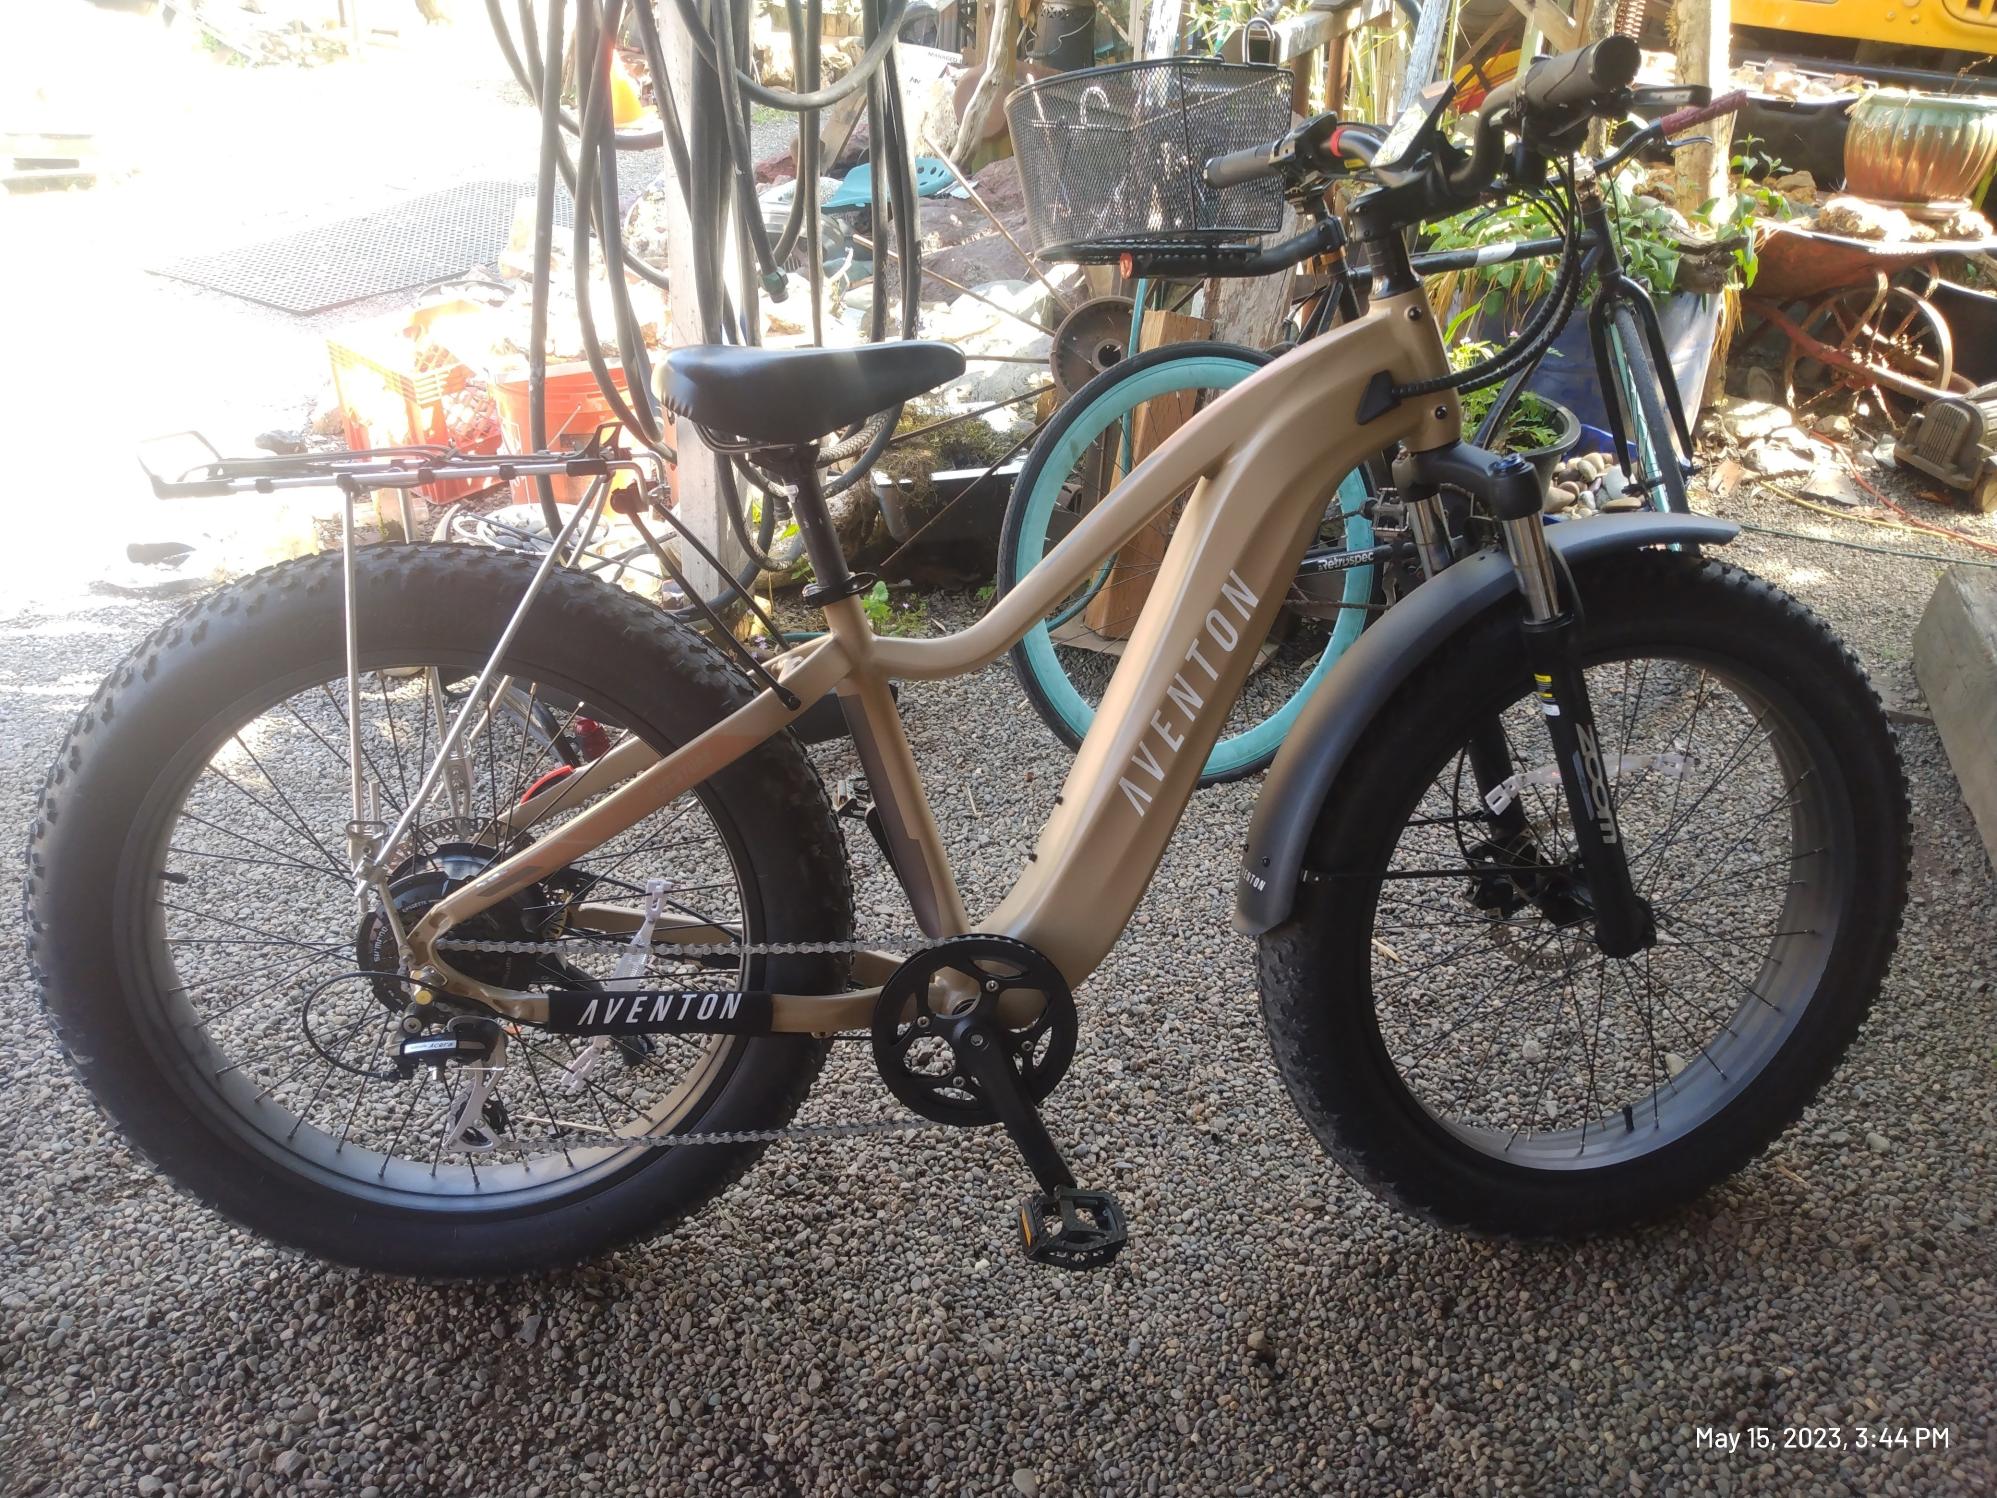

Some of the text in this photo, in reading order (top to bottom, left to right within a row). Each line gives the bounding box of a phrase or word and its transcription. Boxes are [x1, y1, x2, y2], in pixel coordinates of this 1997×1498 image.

[1318, 551, 1375, 571] Retrospec
[1118, 569, 1259, 818] AVENTON
[578, 993, 742, 1026] AVENTON
